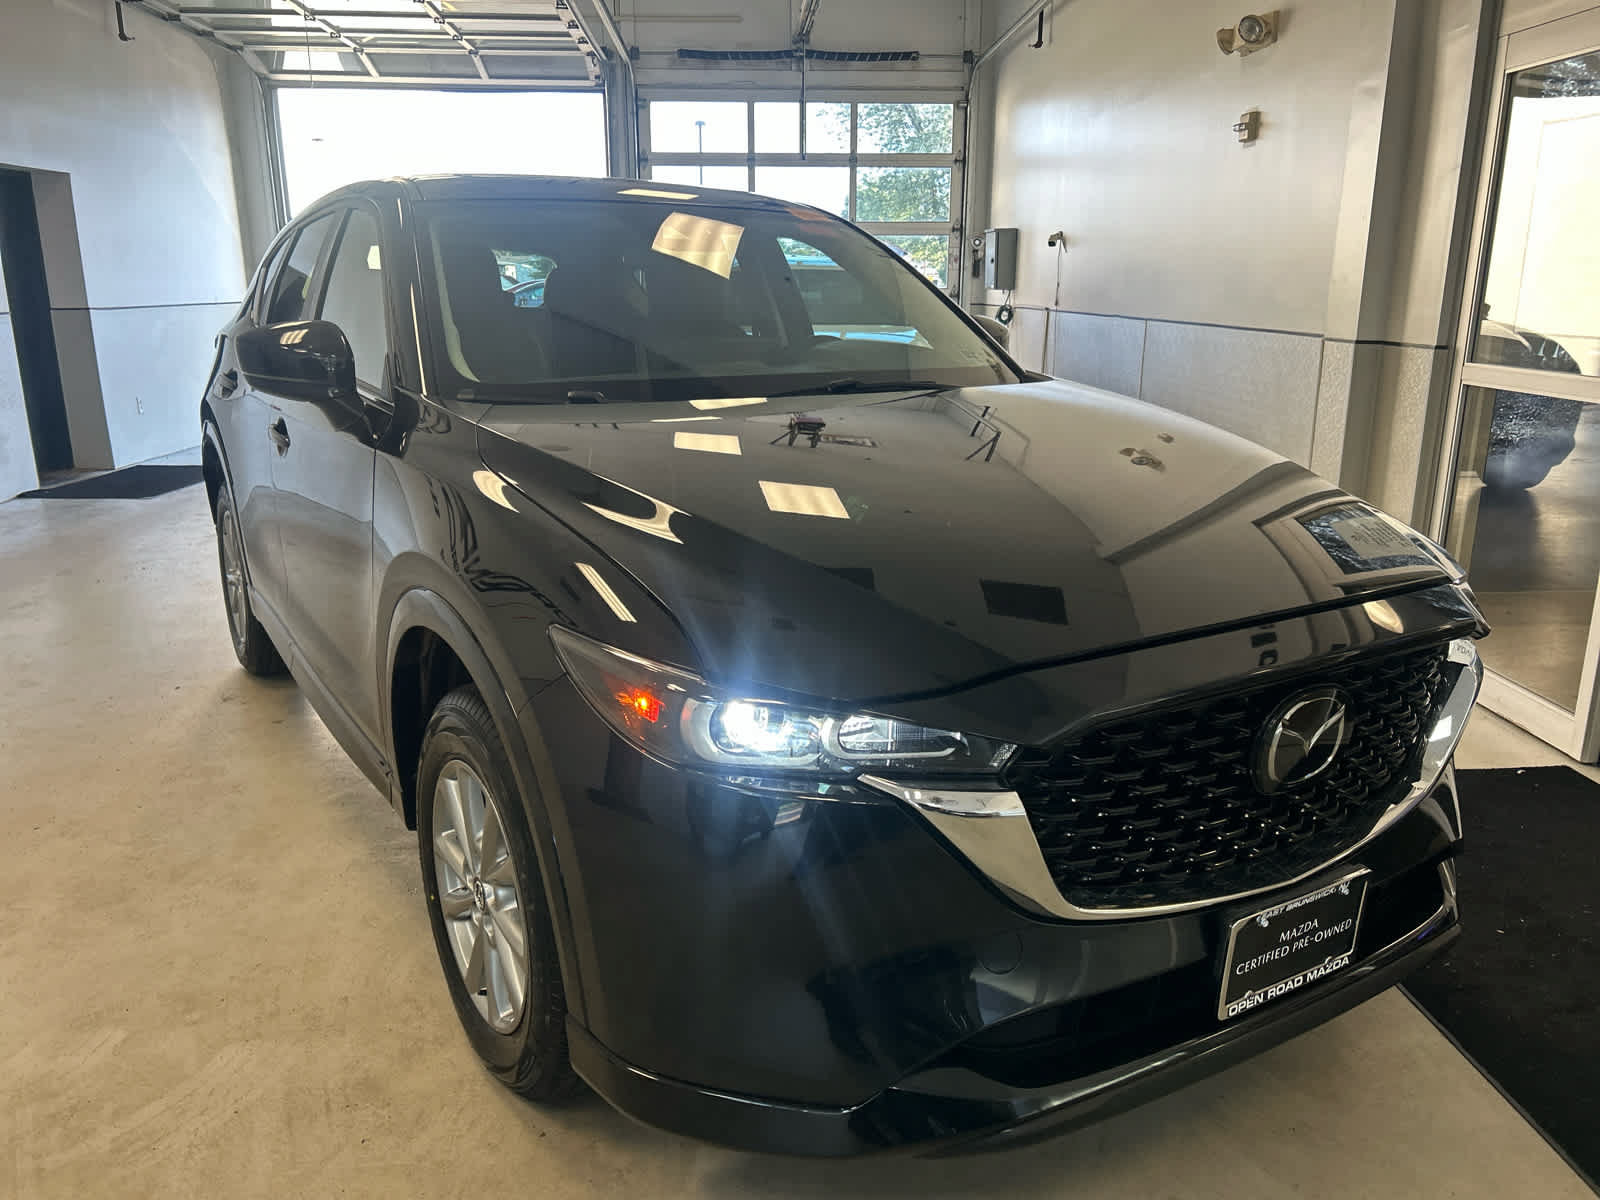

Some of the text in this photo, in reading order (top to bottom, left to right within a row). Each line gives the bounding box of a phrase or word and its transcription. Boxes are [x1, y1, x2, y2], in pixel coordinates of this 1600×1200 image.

[1236, 918, 1352, 975] CERTIFIED PRE-OWNED
[1279, 918, 1319, 943] MAZDA
[1228, 956, 1350, 1017] OPEN ROAD MAZDA
